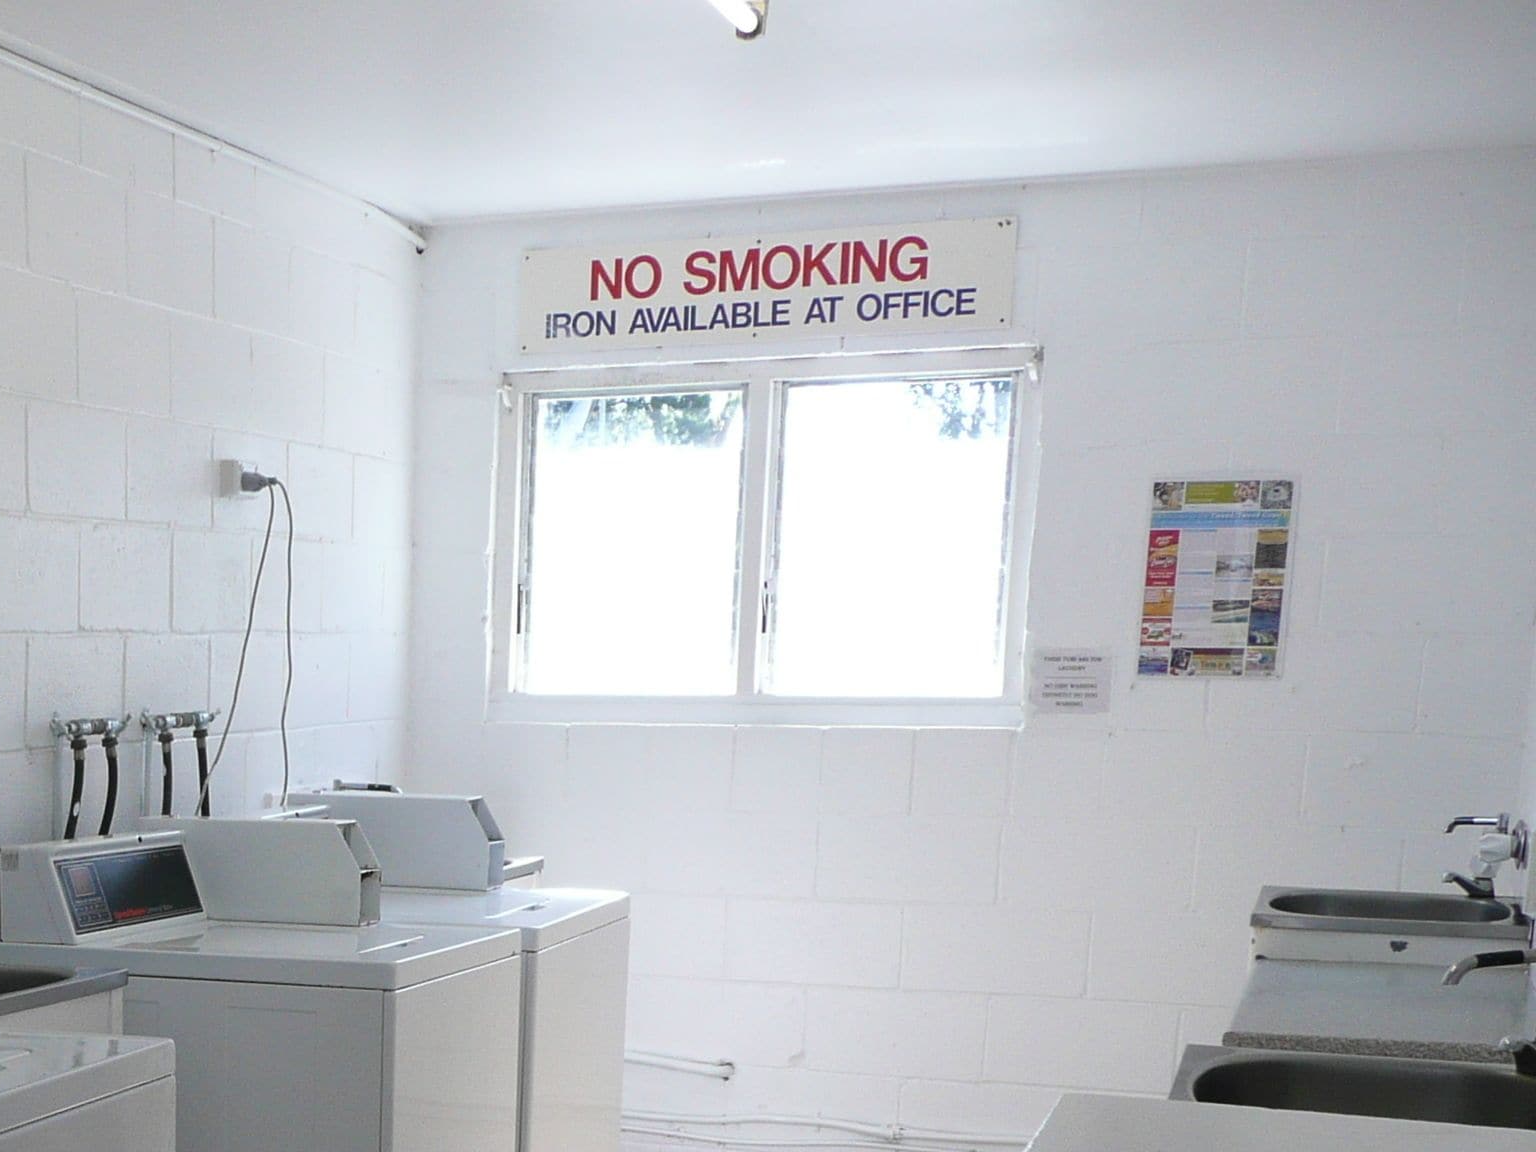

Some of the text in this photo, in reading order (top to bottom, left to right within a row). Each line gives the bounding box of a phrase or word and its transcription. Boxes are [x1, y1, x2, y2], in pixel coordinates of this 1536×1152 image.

[589, 235, 929, 301] NO SMOKING
[545, 287, 977, 340] IRON AVAILABLE AT OFFICE
